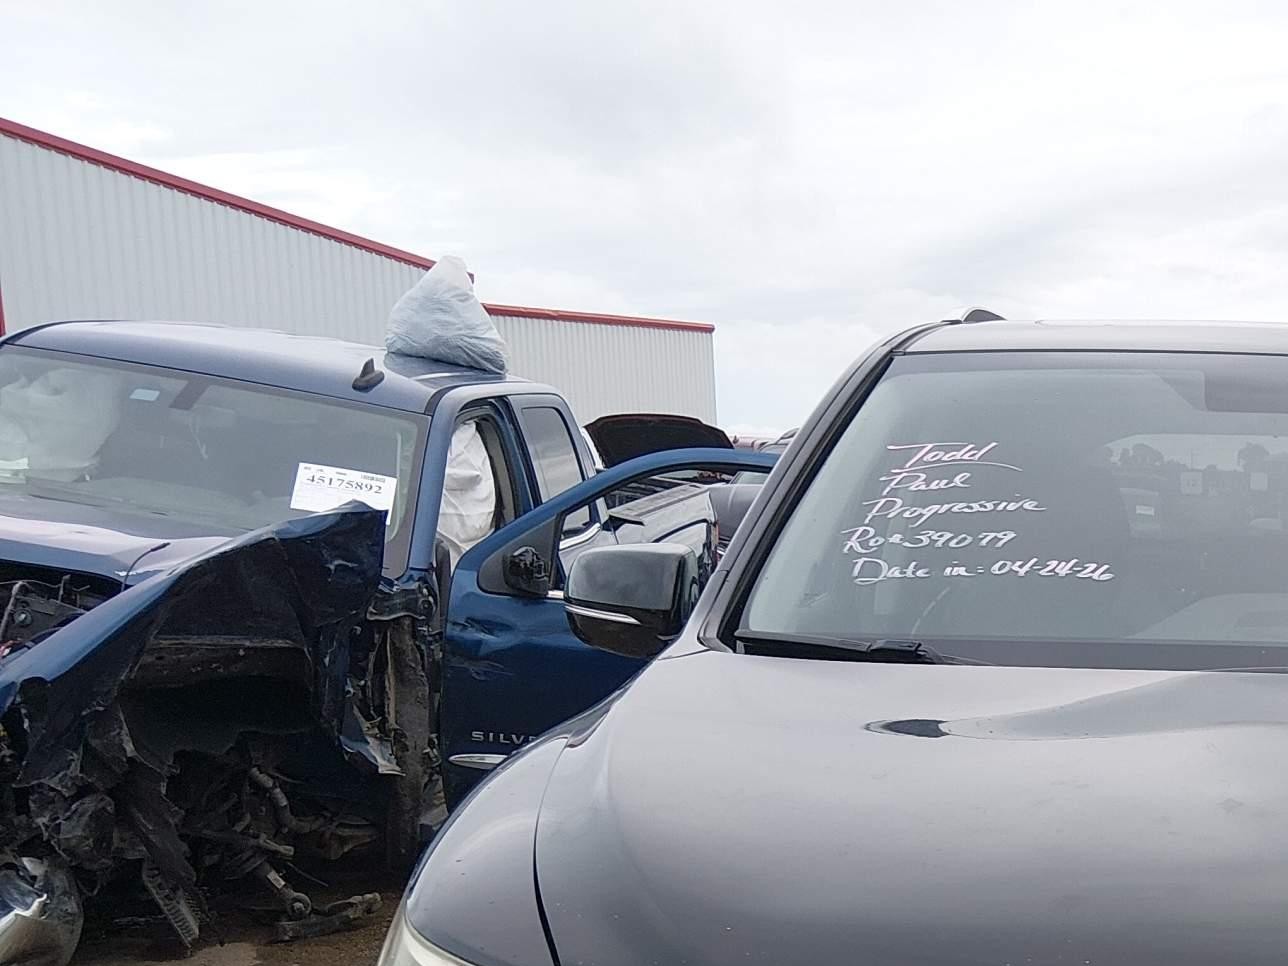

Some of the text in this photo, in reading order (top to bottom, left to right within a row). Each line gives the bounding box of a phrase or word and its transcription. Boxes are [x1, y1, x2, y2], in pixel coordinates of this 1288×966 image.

[887, 442, 998, 469] Todd
[306, 474, 383, 495] 45175892
[879, 472, 971, 496] Paul
[862, 494, 1047, 528] Progressive
[851, 557, 931, 586] Date
[990, 557, 1115, 581] 04-24-26
